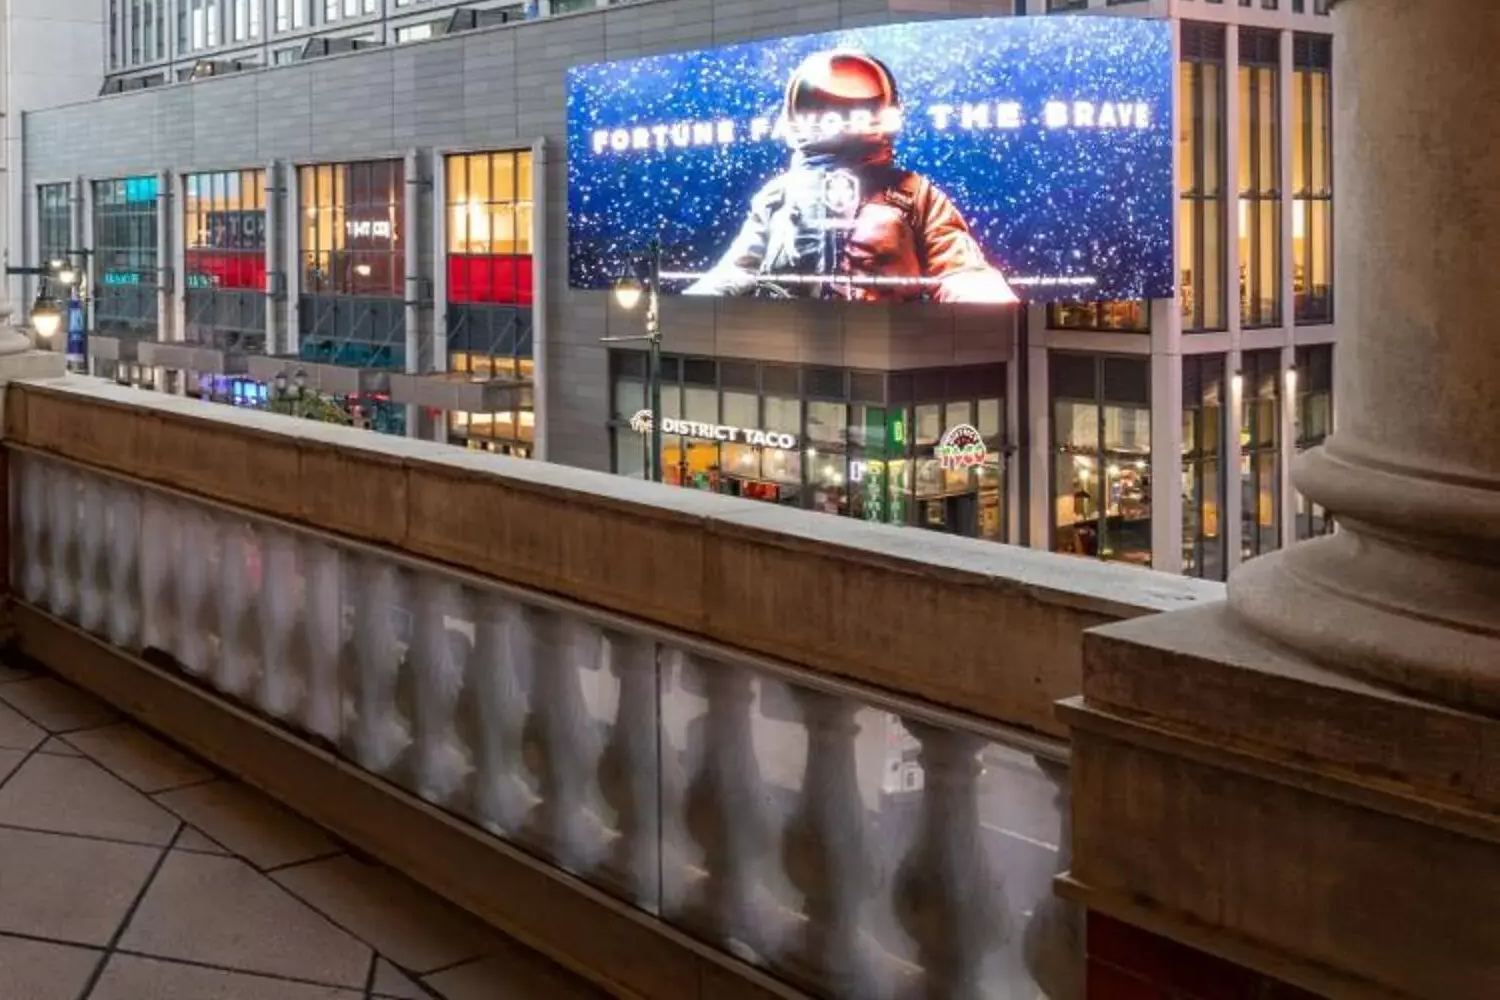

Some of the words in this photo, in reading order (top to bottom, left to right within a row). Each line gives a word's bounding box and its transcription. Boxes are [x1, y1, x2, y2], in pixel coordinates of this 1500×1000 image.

[592, 119, 735, 154] FORTUNE
[927, 102, 1021, 130] THE
[1045, 100, 1149, 129] BRAVE
[661, 417, 740, 441] DISTRICT
[742, 428, 796, 449] TACO
